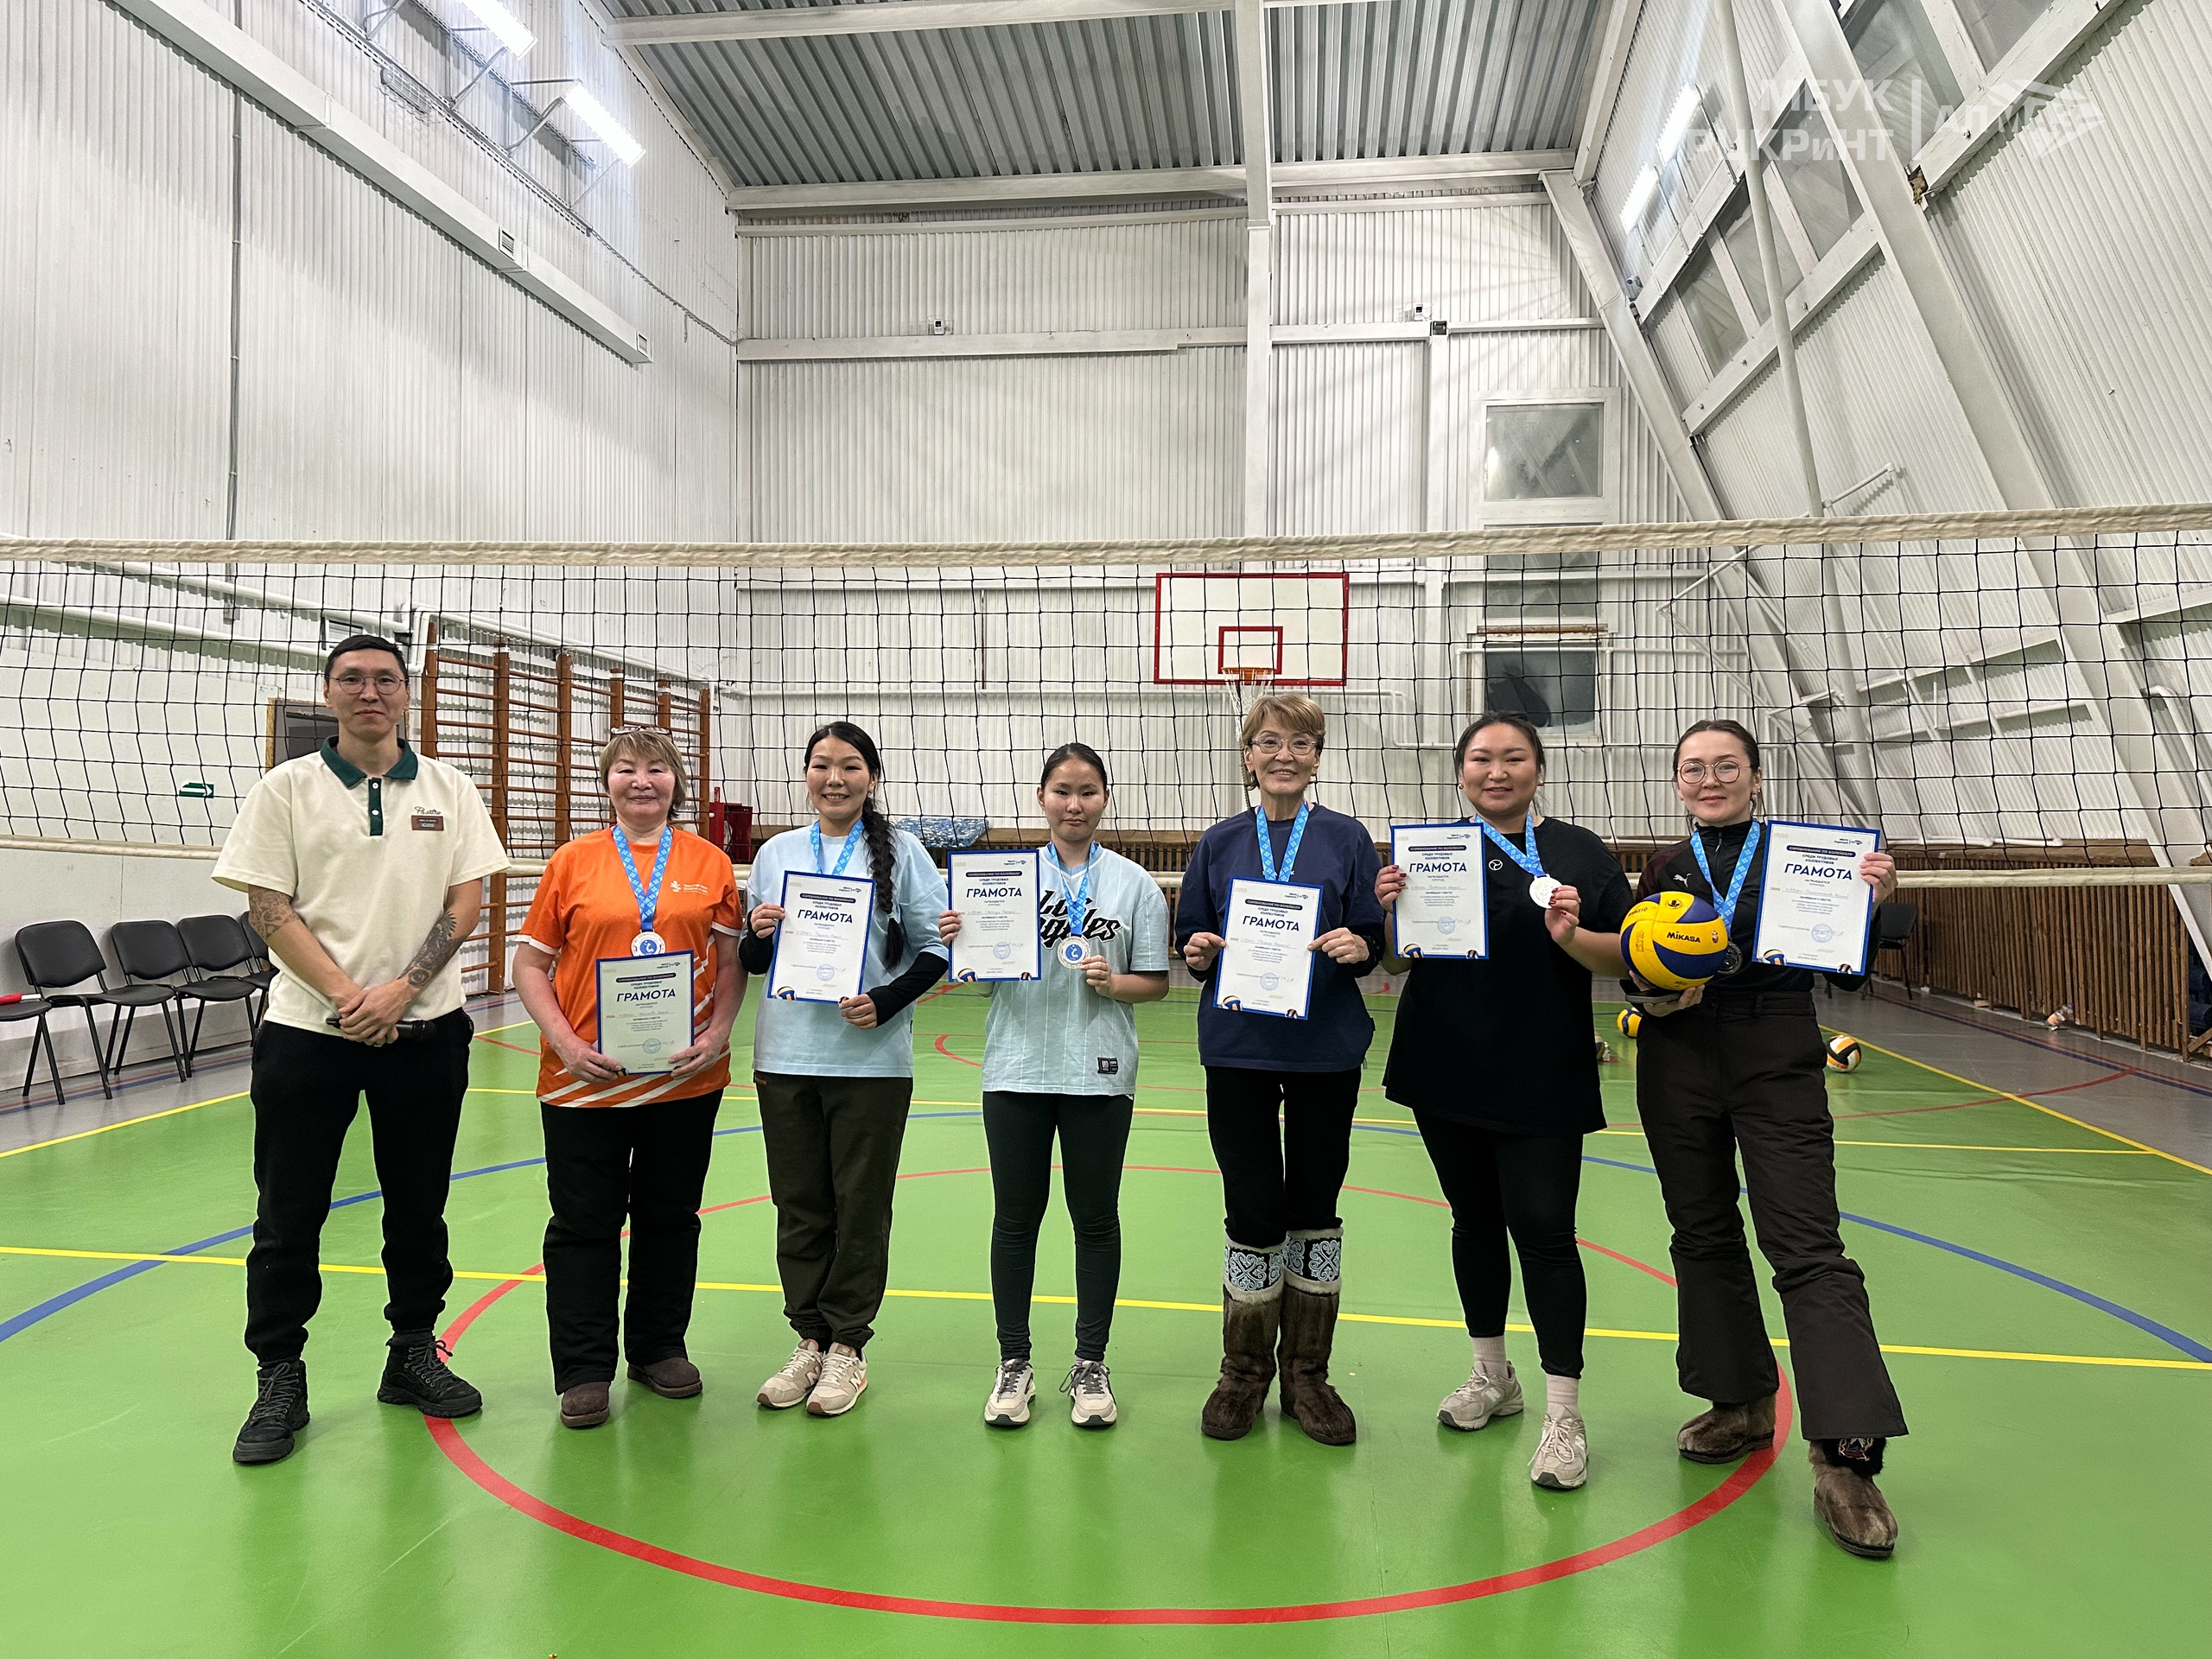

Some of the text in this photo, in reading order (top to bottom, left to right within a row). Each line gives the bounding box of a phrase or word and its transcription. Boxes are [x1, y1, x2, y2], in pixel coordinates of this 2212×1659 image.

[1409, 862, 1466, 873] ГРАМОТА
[1784, 863, 1852, 880] ГРАМОТА
[967, 887, 1021, 898] ГРАМОТА
[798, 909, 853, 924] ГРАМОТА
[1243, 916, 1299, 931] ГРАМОТА
[617, 988, 676, 1002] ГРАМОТА
